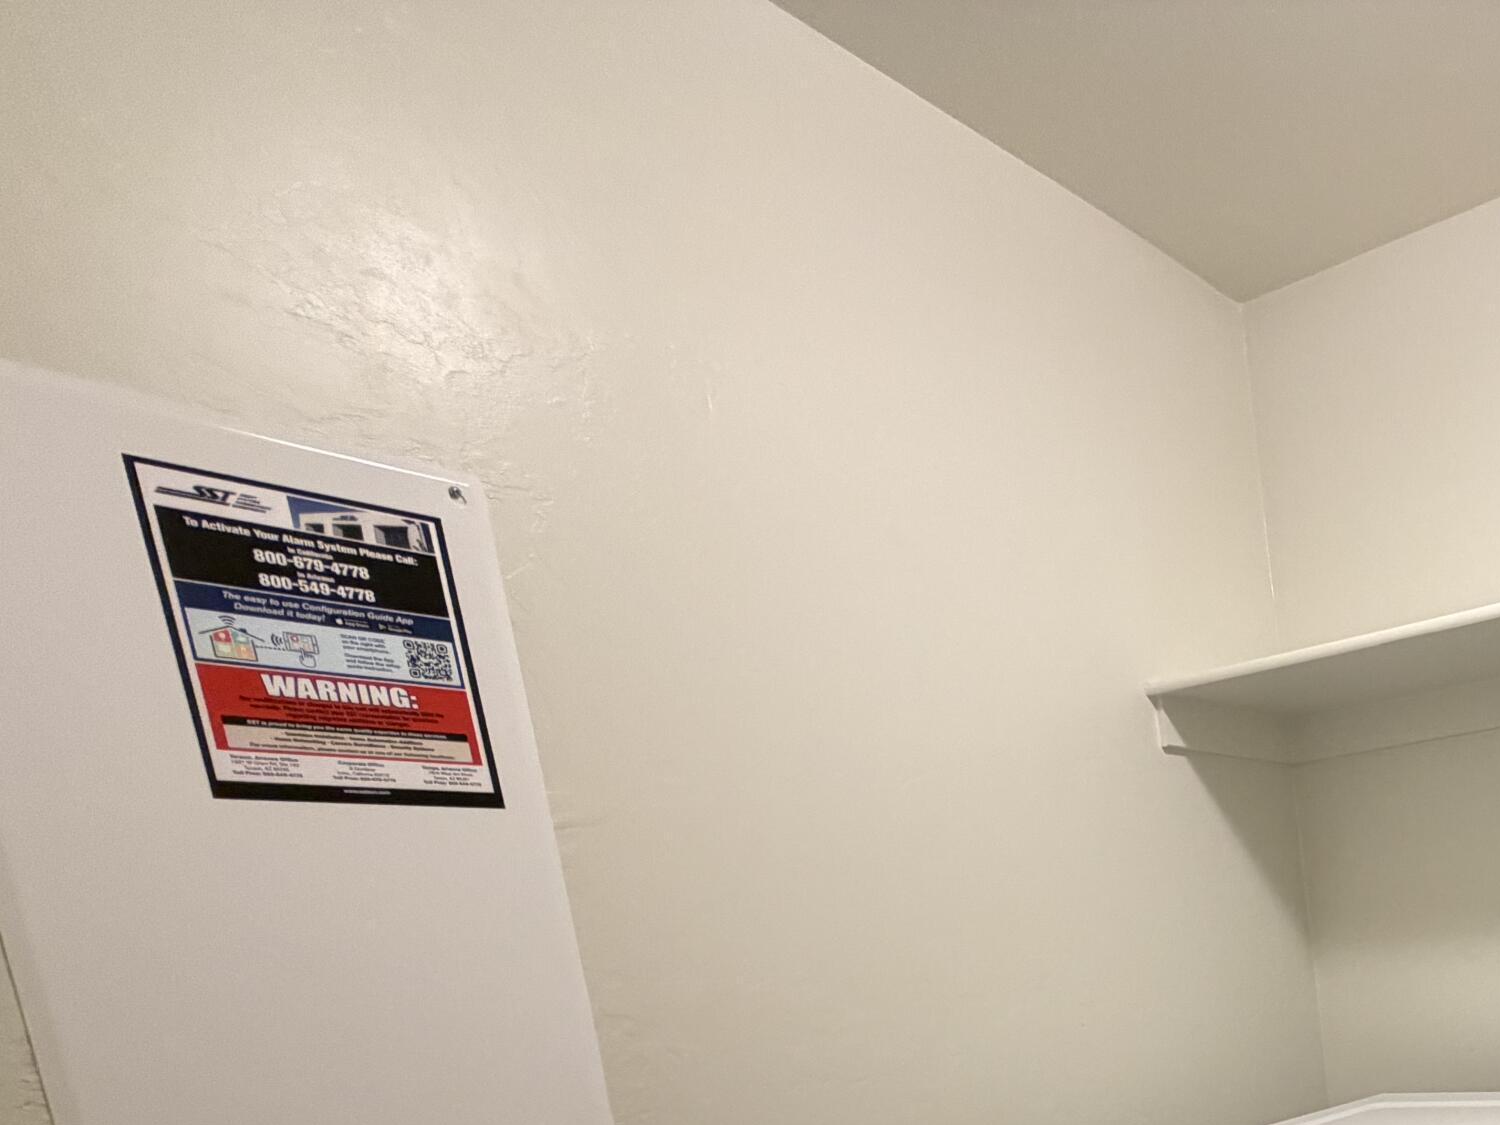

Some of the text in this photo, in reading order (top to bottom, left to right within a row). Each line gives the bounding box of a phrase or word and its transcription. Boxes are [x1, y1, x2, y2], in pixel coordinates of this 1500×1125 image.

[182, 516, 418, 566] To Activate Your Alarm System Please Call:
[252, 548, 370, 580] 800-679-4778
[258, 573, 376, 603] 800-549-4778
[222, 590, 241, 600] The
[243, 595, 267, 606] easy
[269, 598, 280, 606] to
[282, 601, 300, 609] use
[302, 602, 365, 618] Configuration
[367, 611, 394, 622] Guide
[395, 616, 414, 626] App
[233, 602, 285, 616] Download
[296, 611, 326, 622] today!
[260, 673, 419, 710] WARNING:
